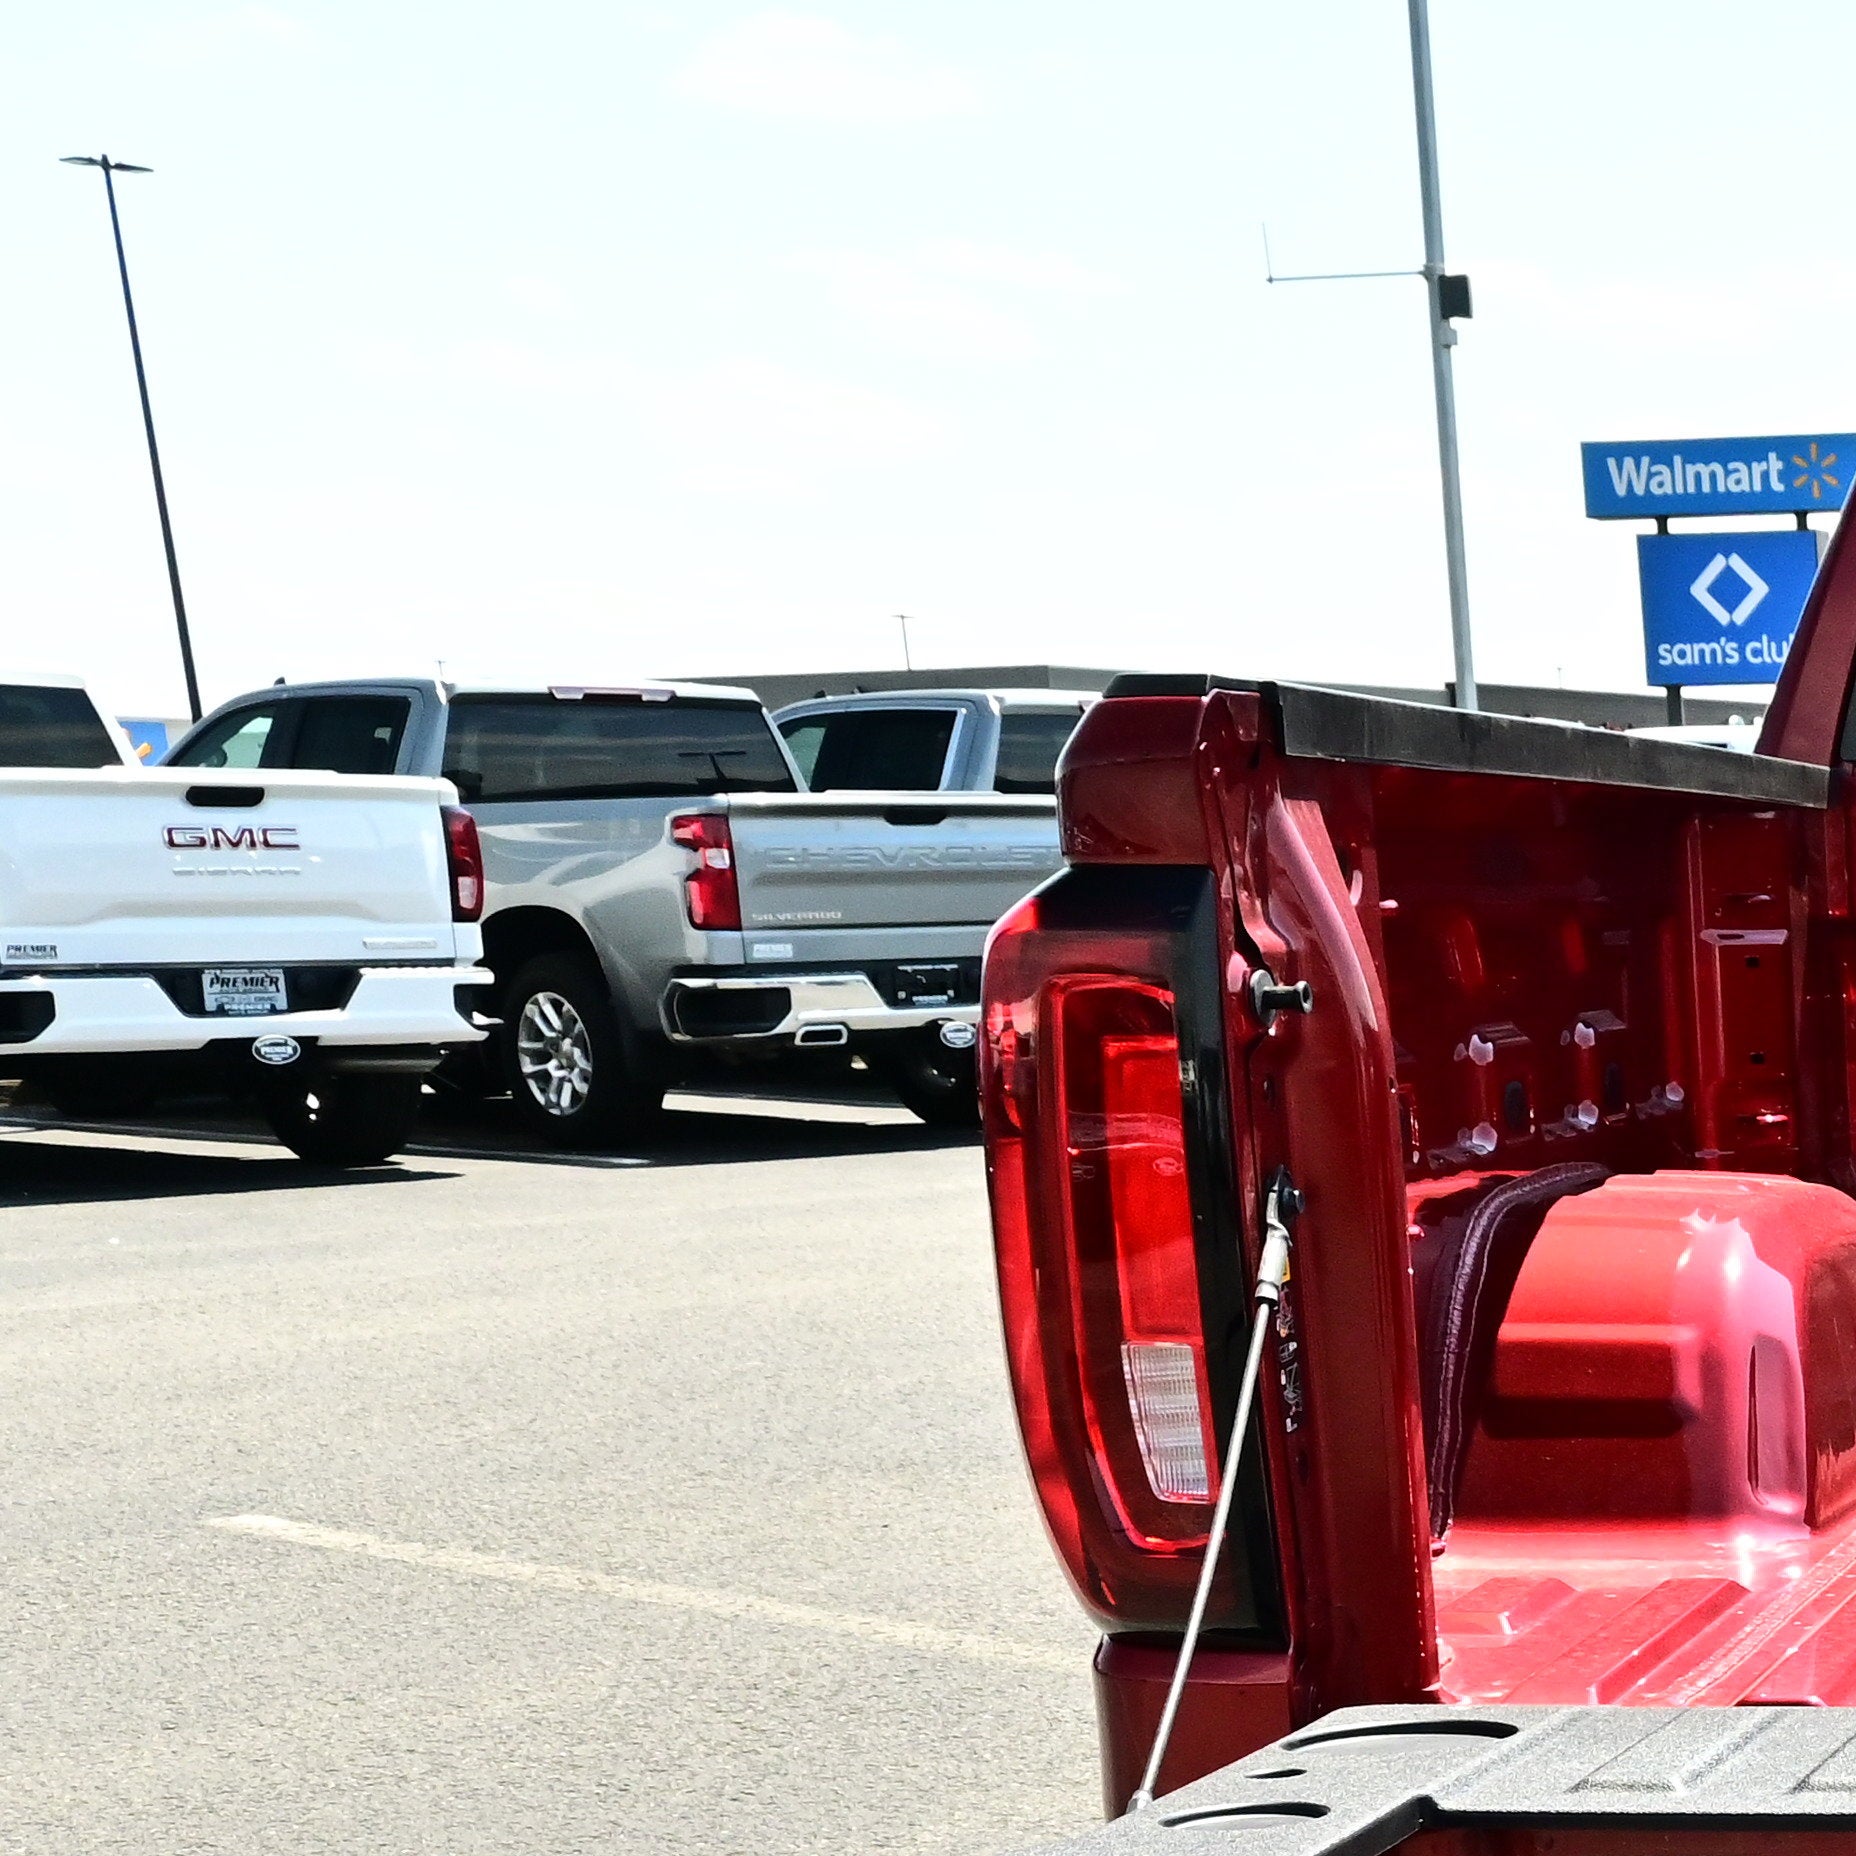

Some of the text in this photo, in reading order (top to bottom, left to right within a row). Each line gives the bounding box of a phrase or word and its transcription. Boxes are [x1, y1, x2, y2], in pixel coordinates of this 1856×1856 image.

[1606, 451, 1785, 497] Walmart
[1658, 637, 1740, 666] sam's
[164, 825, 301, 850] GMC
[208, 971, 280, 993] PREMIER
